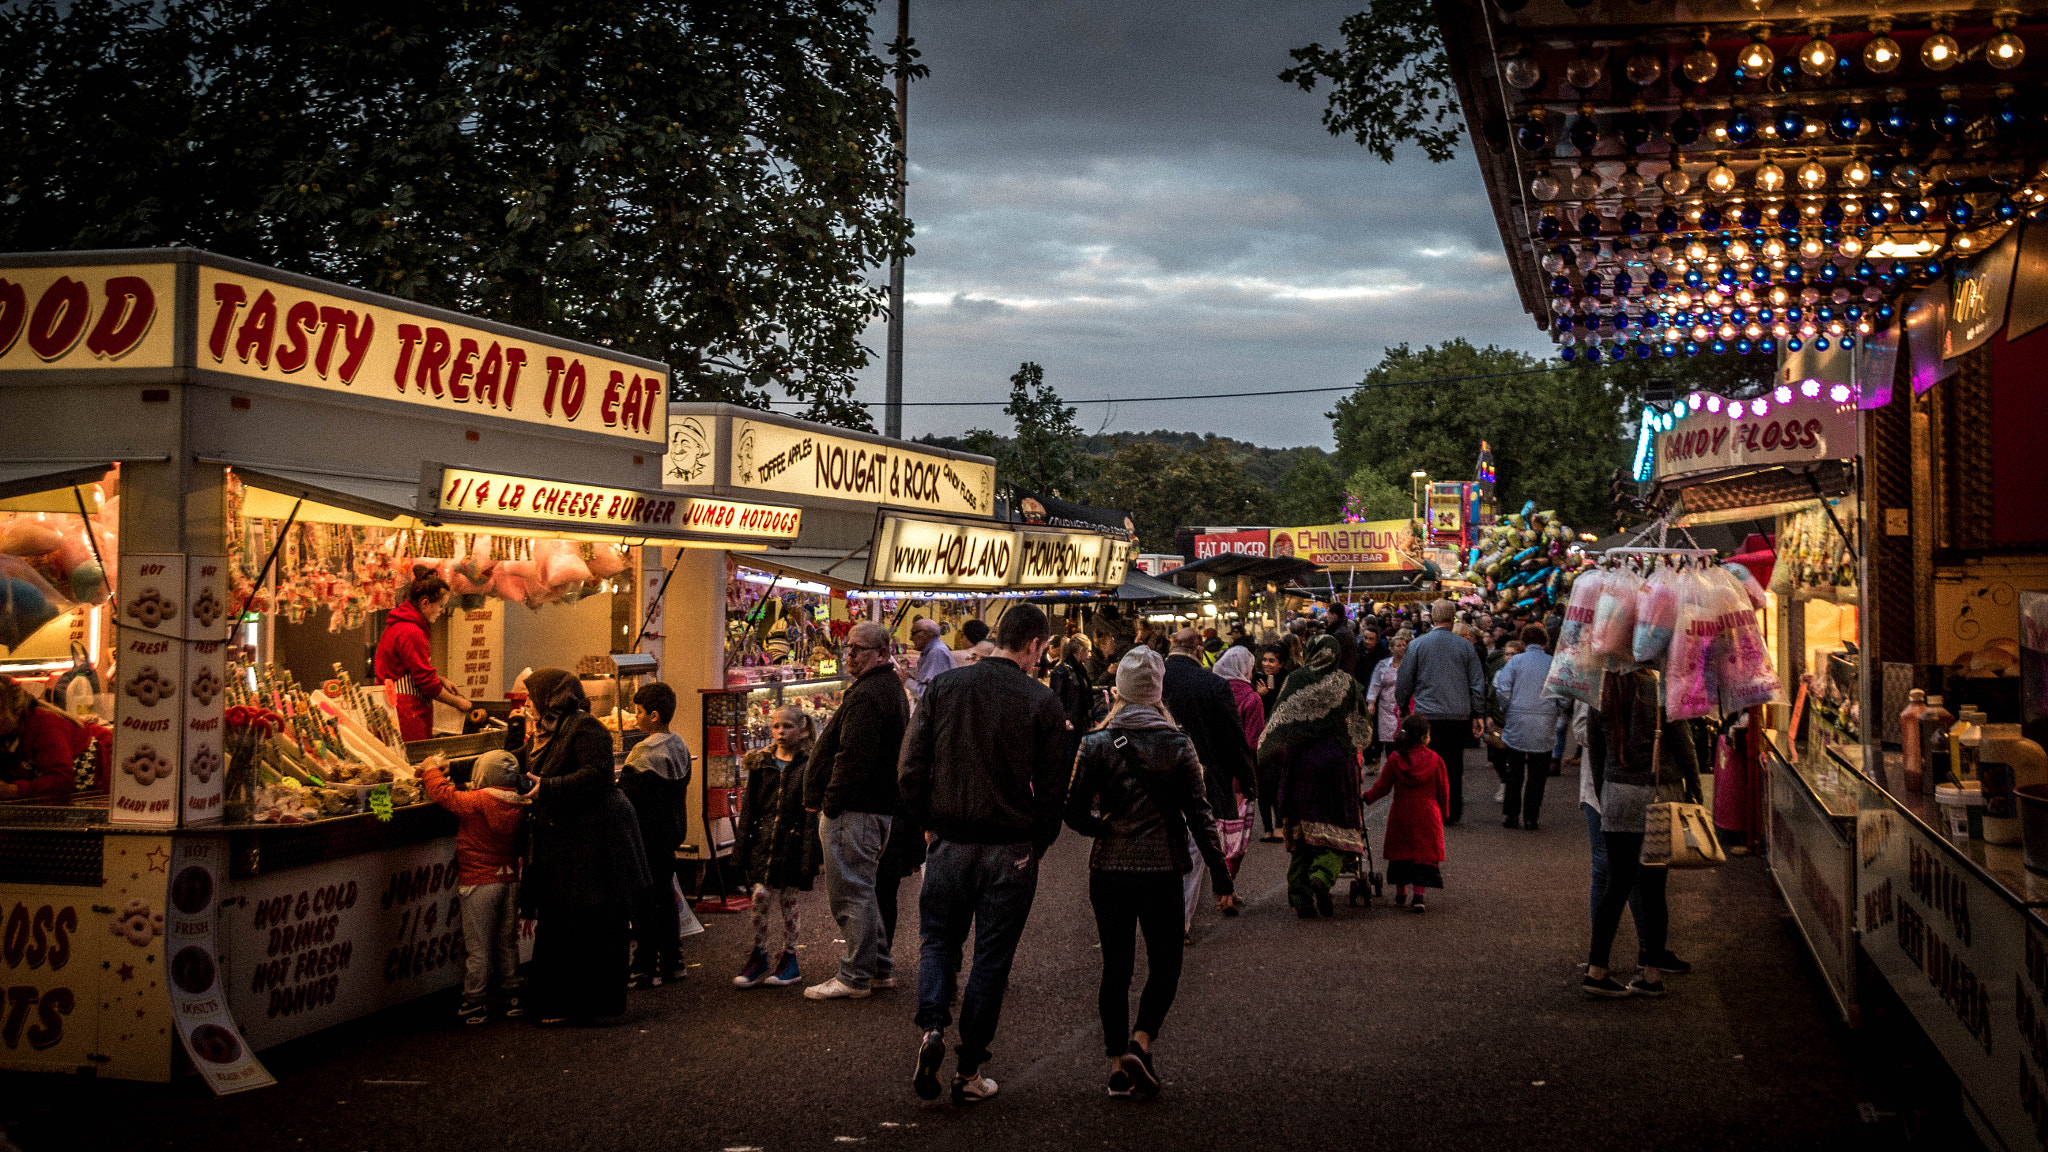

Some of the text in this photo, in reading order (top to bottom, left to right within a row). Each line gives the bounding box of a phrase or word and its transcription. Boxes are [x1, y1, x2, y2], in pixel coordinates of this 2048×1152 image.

[209, 283, 660, 434] TASTY TREAT TO EAT
[1665, 418, 1822, 463] CANDY FLOSS
[758, 437, 813, 484] TOFFEE APPLES
[815, 441, 941, 503] NOUGAT & ROCK
[943, 463, 977, 511] CANDY FLOSS
[446, 478, 798, 533] 1/4 LB CHEESE BURGER JUMBO HOTDOGS
[1198, 541, 1217, 559] FAT
[1316, 552, 1382, 563] NOODLE BAR
[140, 563, 165, 576] HOT
[201, 565, 217, 577] HOT
[129, 640, 169, 655] FRESH
[122, 716, 170, 732] DONUTS
[190, 717, 219, 731] DONUTS
[116, 796, 170, 812] READY NOW
[184, 845, 210, 859] HOT
[382, 862, 458, 910] JUMBO
[254, 880, 358, 930] HOT & COLD
[174, 921, 209, 937] FRESH
[267, 914, 340, 957] DRINKS
[252, 941, 352, 994] HOT FRESH
[181, 999, 219, 1016] DONUTS
[267, 974, 340, 1020] DONUTS
